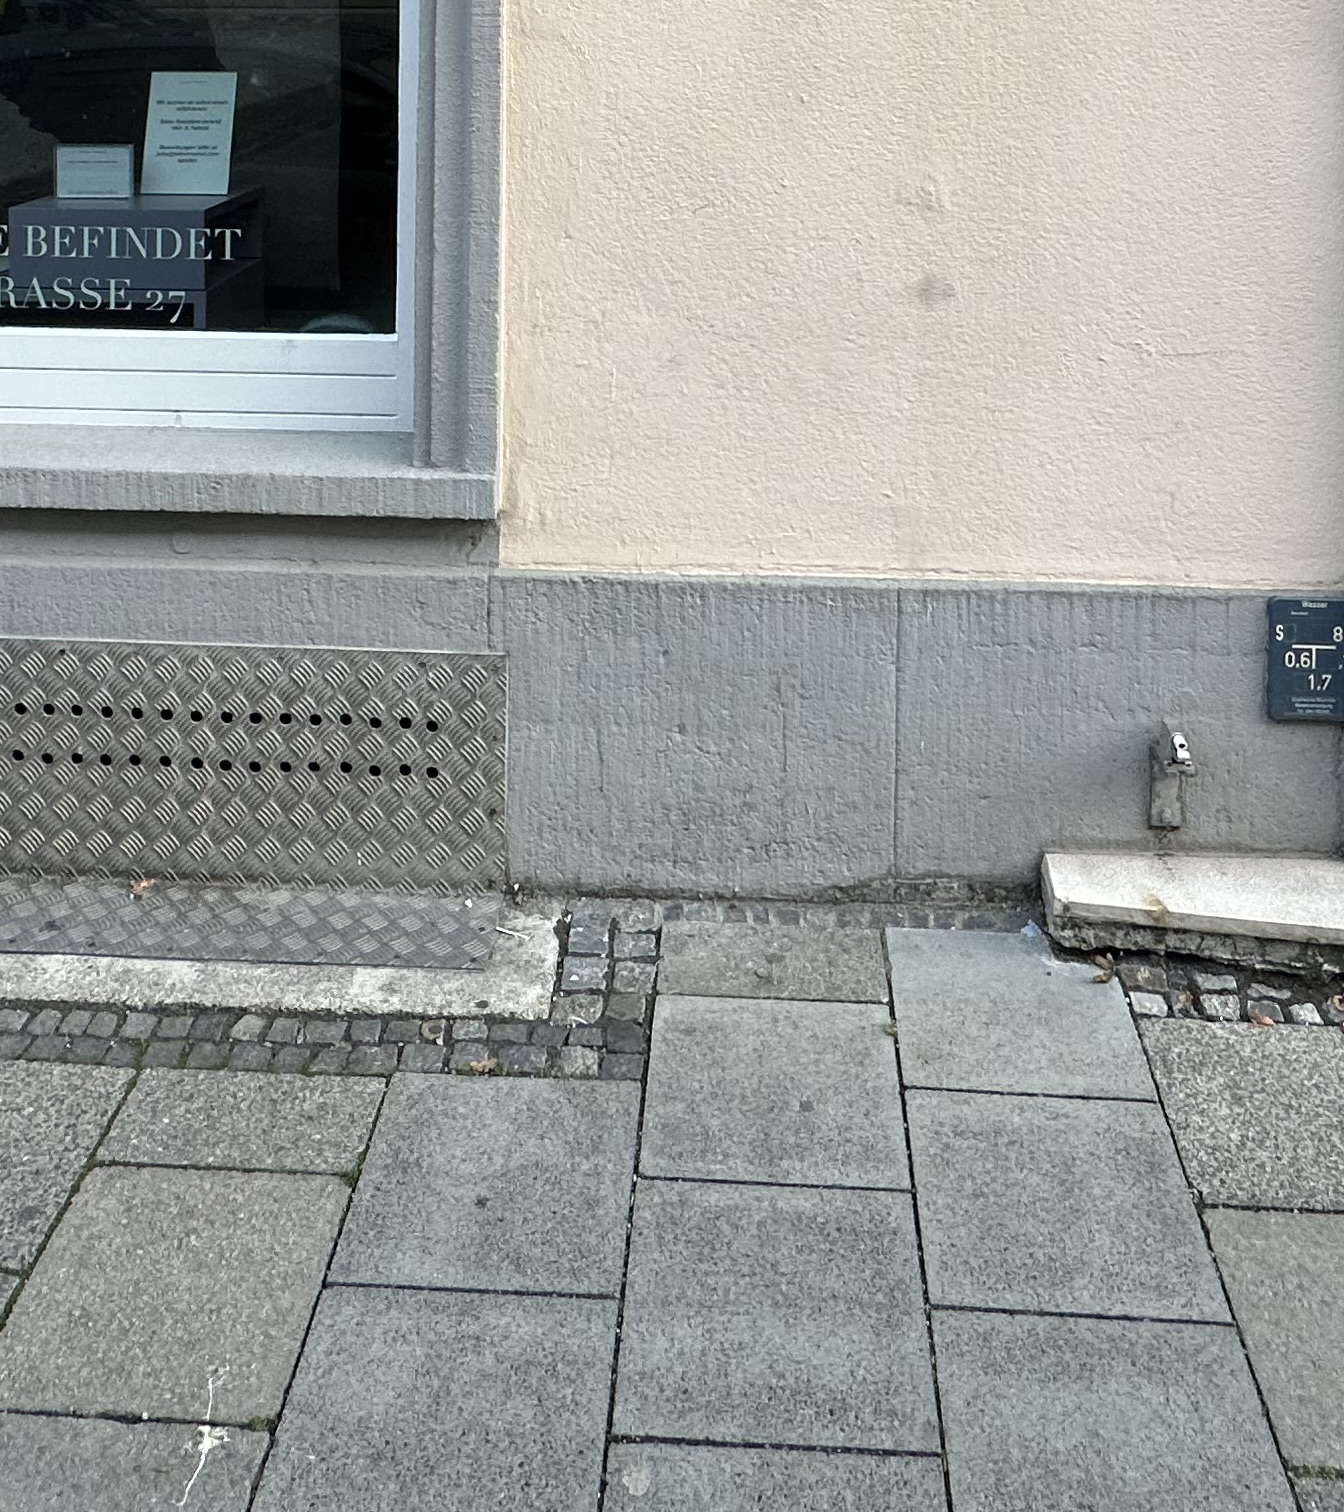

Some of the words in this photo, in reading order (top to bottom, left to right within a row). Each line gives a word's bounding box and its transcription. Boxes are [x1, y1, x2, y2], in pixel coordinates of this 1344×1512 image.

[22, 224, 242, 261] BEFINDET
[144, 290, 186, 324] 27
[1275, 624, 1284, 641] S
[1284, 651, 1310, 668] 0.6
